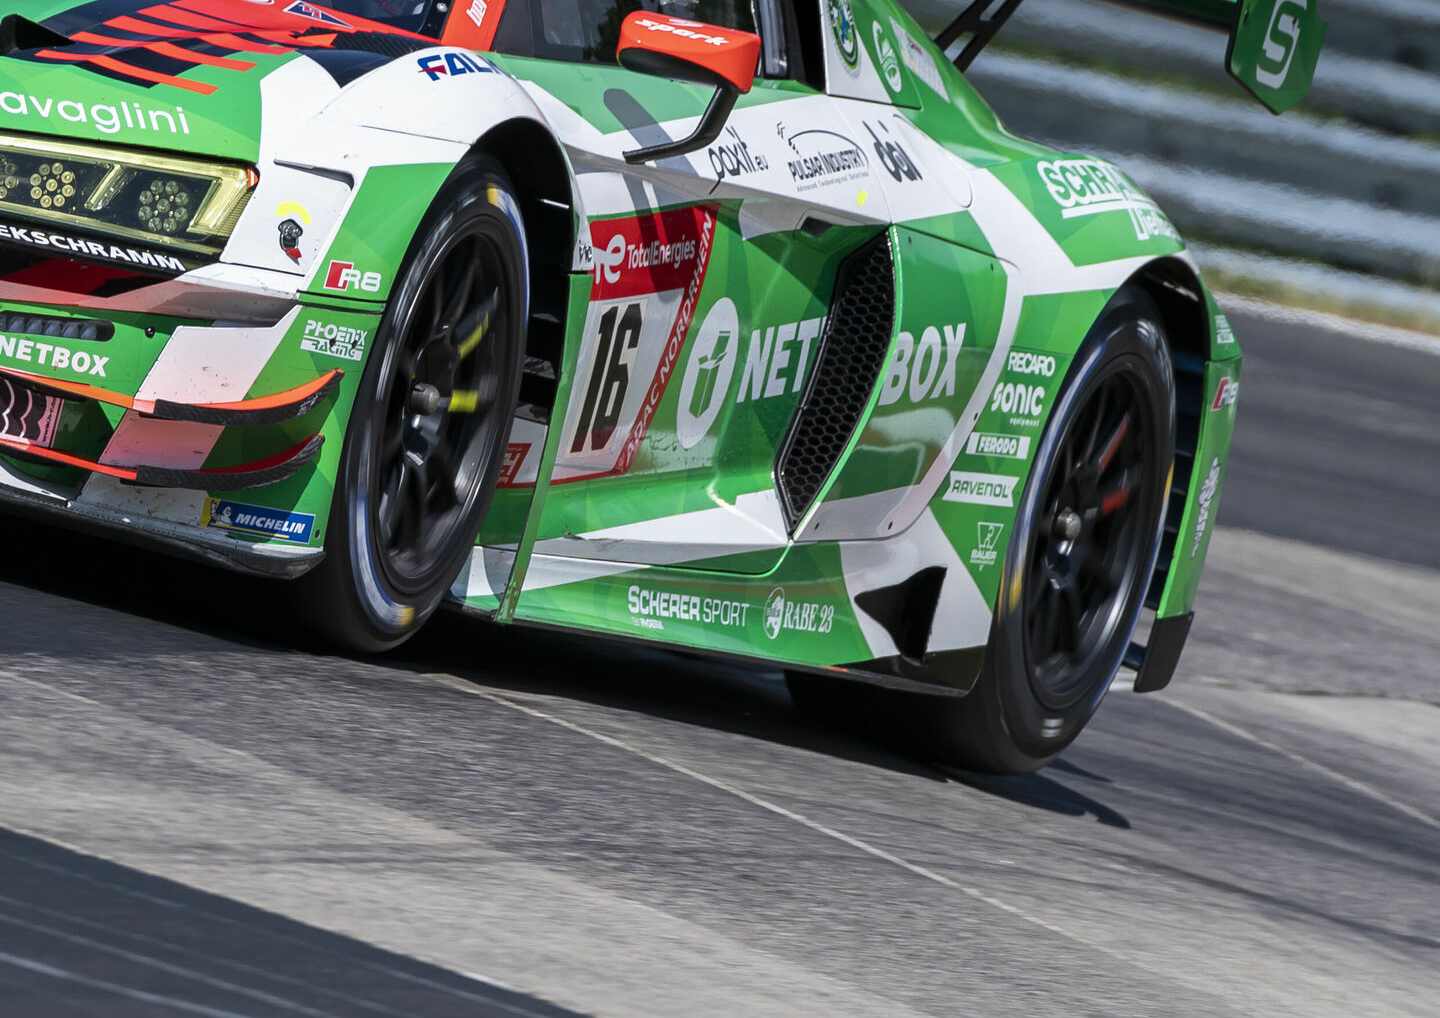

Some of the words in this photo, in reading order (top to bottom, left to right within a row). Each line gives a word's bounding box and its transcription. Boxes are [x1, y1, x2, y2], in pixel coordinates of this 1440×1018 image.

[626, 233, 697, 270] TotalEnergies
[336, 266, 382, 293] R8
[1007, 350, 1056, 378] RECARO
[570, 302, 643, 455] 16
[977, 436, 1018, 457] FERODO
[951, 479, 1011, 499] RAVENOL
[234, 512, 307, 534] MICHELIN
[627, 584, 701, 622] SCHERER
[702, 597, 751, 628] SPORT
[782, 600, 820, 632] RABE
[818, 605, 835, 634] 23
